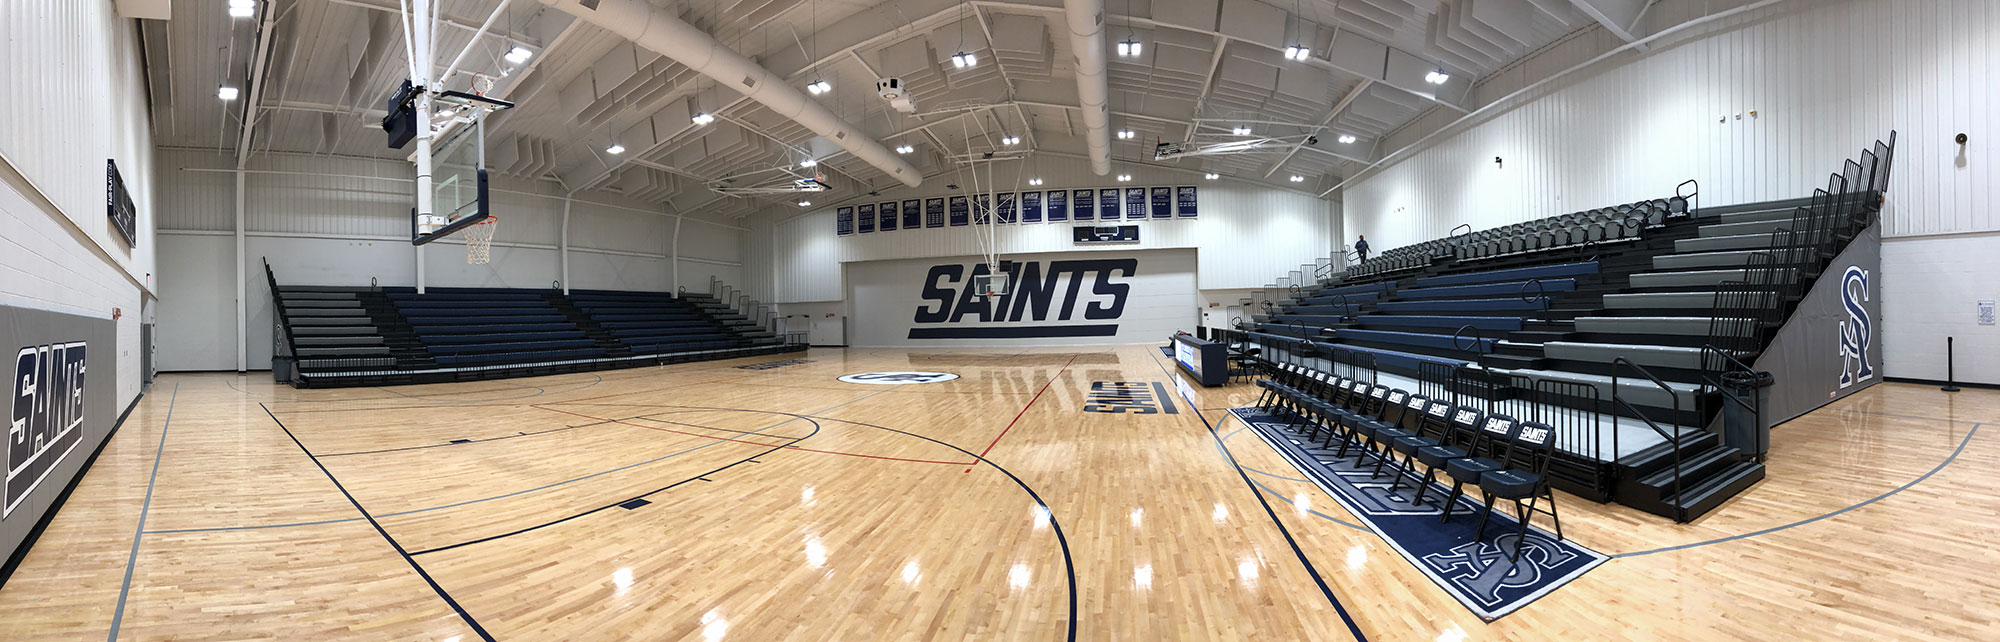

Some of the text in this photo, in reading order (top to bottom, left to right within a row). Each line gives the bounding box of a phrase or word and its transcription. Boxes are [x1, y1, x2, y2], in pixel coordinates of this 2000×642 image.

[913, 257, 1139, 324] SAINTS
[7, 340, 88, 473] SAINTS
[1409, 397, 1426, 408] SAINTS
[1429, 403, 1448, 415] SAINTS
[1456, 410, 1477, 423] SAINTS
[1486, 418, 1511, 432] SAINTS
[1520, 426, 1548, 442] SAINTS
